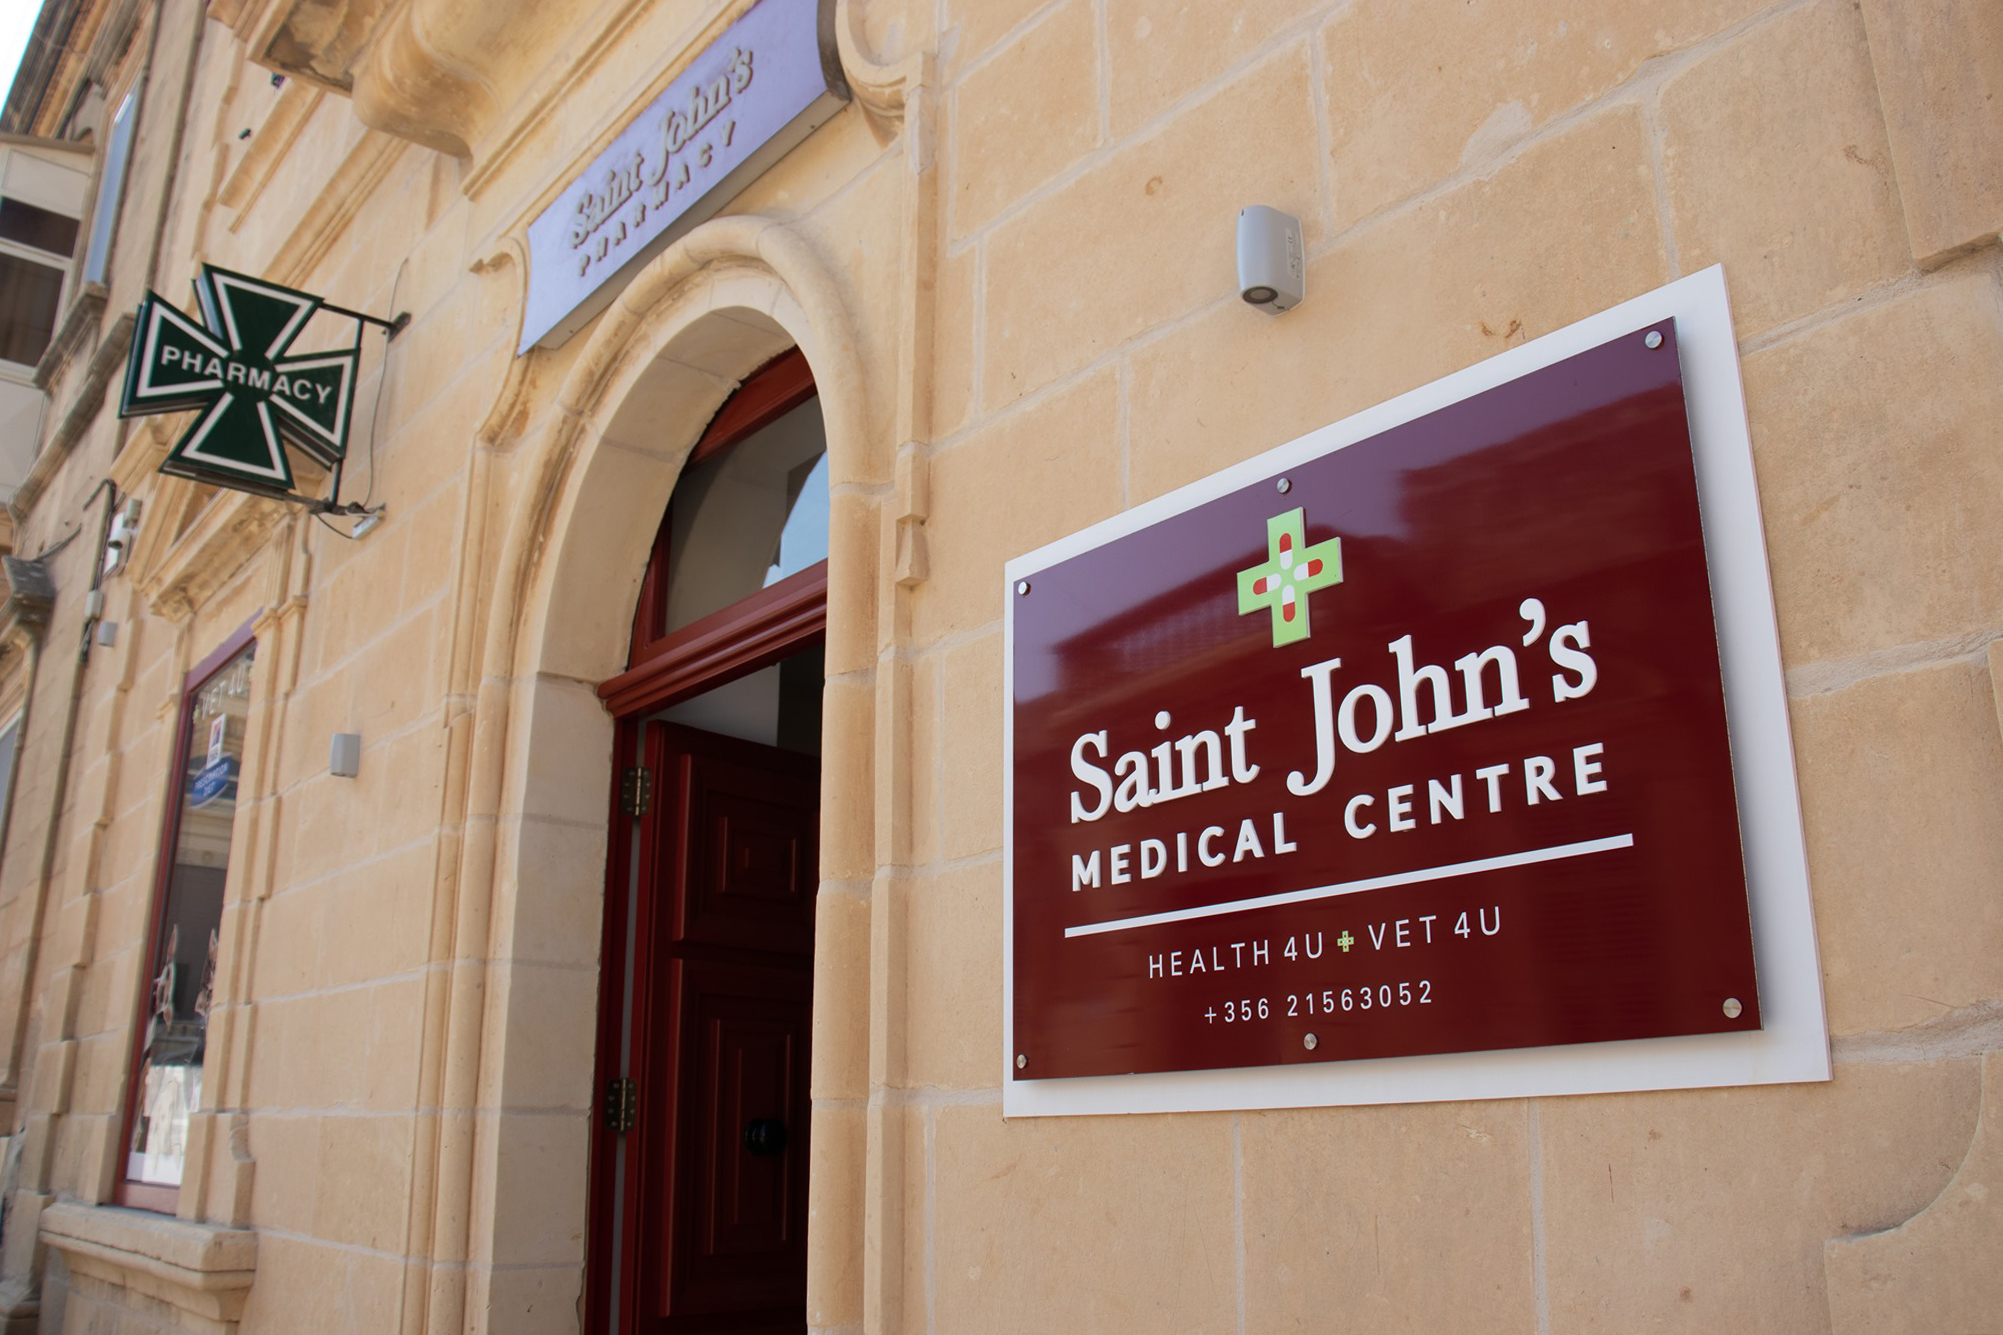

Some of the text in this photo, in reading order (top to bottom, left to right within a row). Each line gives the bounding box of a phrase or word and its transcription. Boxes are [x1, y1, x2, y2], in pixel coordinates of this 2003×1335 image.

[571, 45, 754, 249] Saint John's
[577, 118, 736, 277] PHARMACY
[160, 344, 333, 405] PHARMACY
[1069, 597, 1599, 825] Saint John's
[1071, 742, 1609, 893] MEDICAL CENTRE
[1148, 905, 1501, 979] HEALTH 4U VET 4U
[1204, 980, 1433, 1024] +356 21563052
